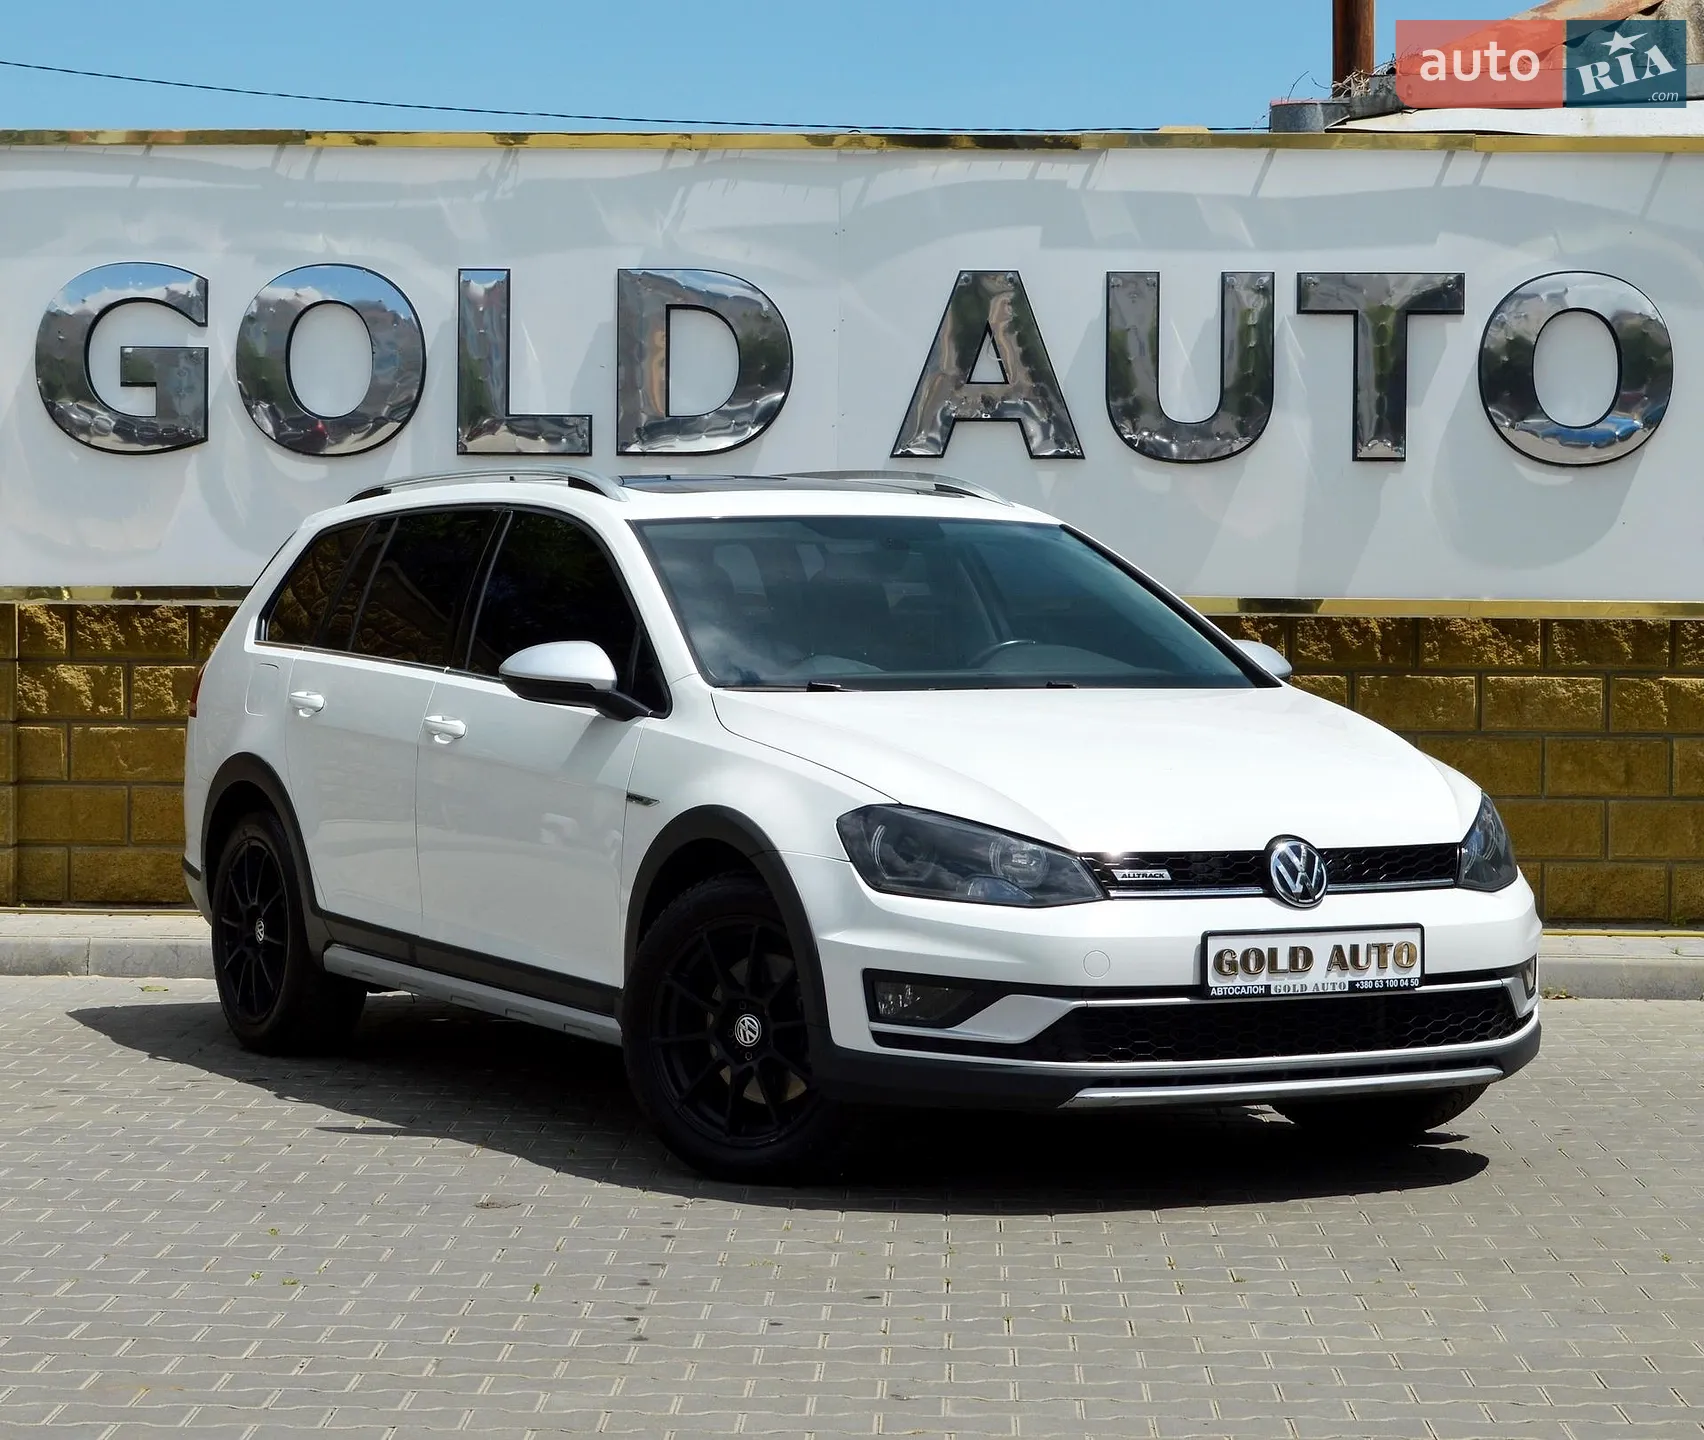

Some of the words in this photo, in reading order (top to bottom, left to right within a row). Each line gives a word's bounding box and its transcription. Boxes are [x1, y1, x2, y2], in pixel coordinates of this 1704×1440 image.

[35, 261, 795, 457] GOLD
[890, 270, 1674, 467] AUTO
[1213, 946, 1314, 976] GOLD
[1327, 941, 1418, 972] AUTO
[1273, 983, 1308, 994] GOLD
[1312, 981, 1347, 992] AUTO
[1355, 980, 1373, 989] +380
[1374, 979, 1384, 988] 63
[1385, 979, 1399, 988] 100
[1399, 978, 1409, 987] 04
[1410, 978, 1419, 987] 50
[1210, 985, 1265, 996] АВТОСАЛОН
